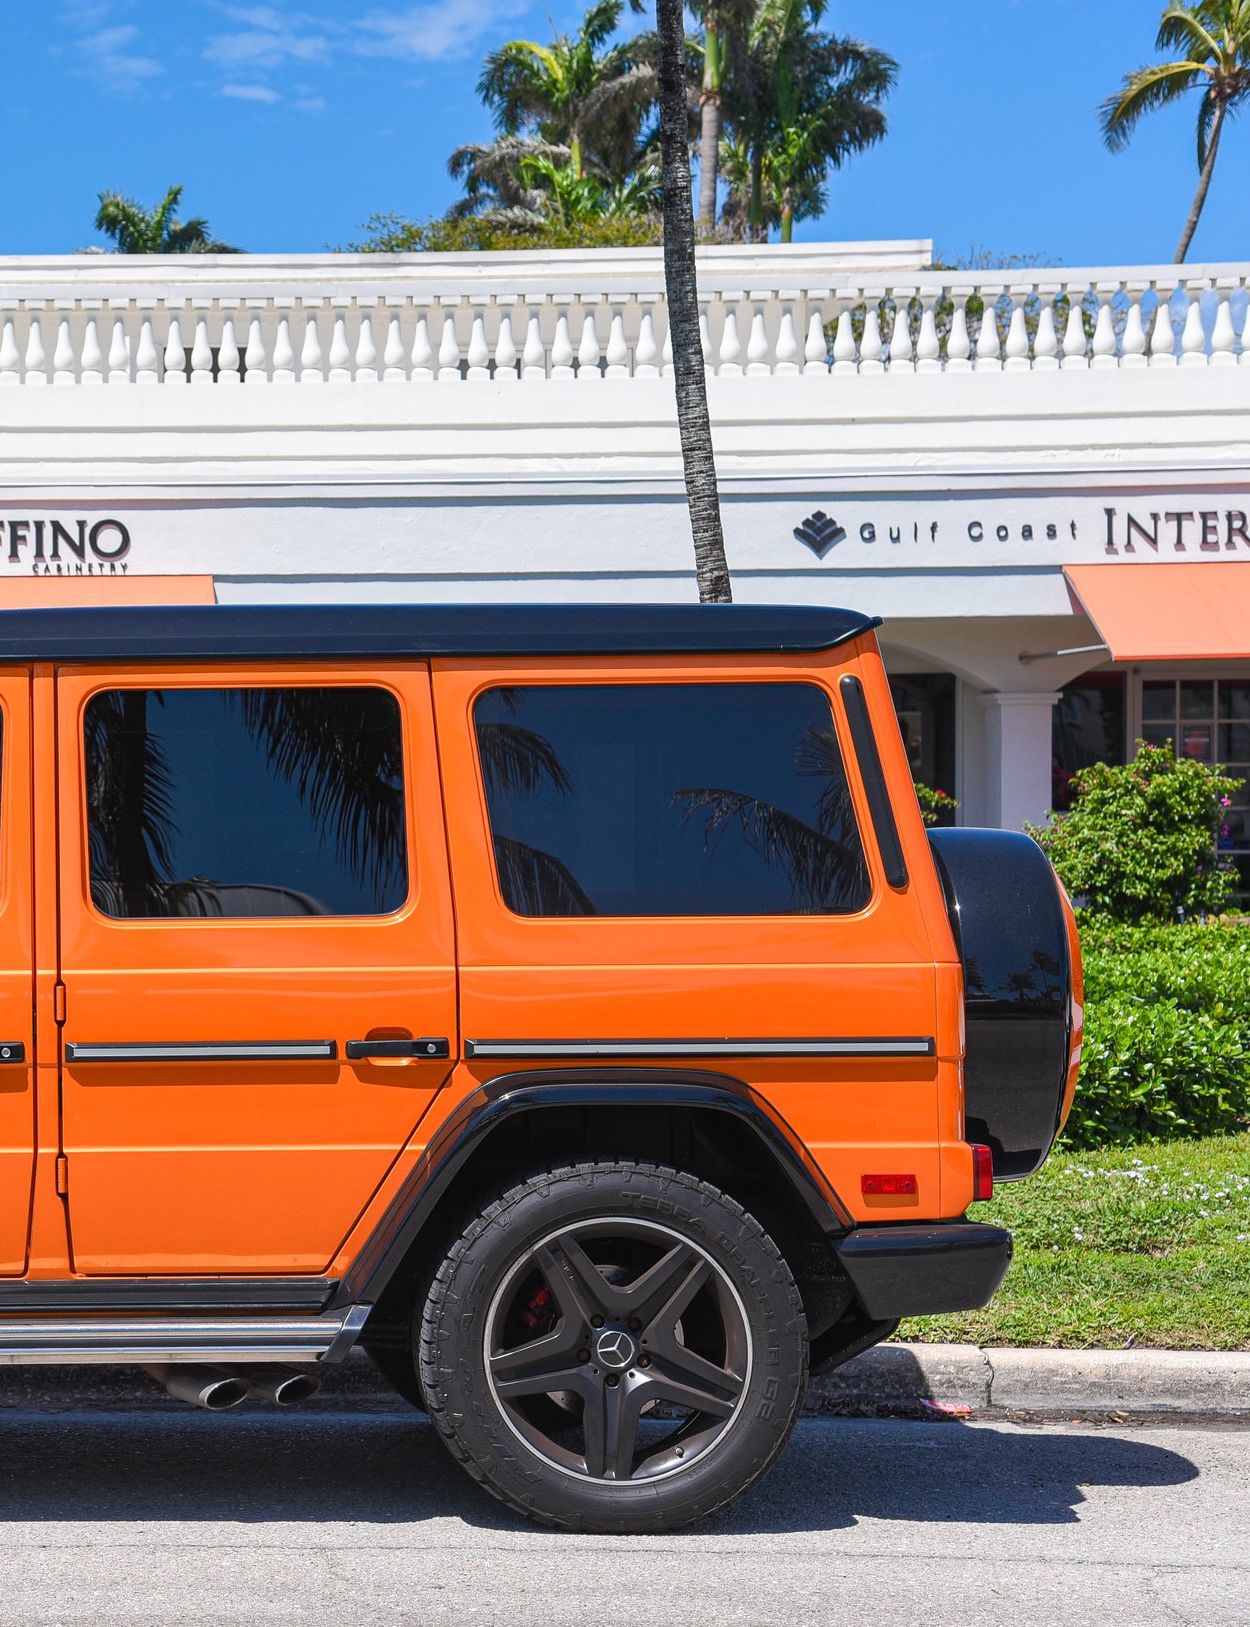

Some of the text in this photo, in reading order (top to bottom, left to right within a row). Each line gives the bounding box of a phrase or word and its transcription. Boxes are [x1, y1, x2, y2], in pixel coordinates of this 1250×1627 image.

[860, 520, 1077, 543] Gulf Coast
[32, 562, 128, 576] CABINETRY
